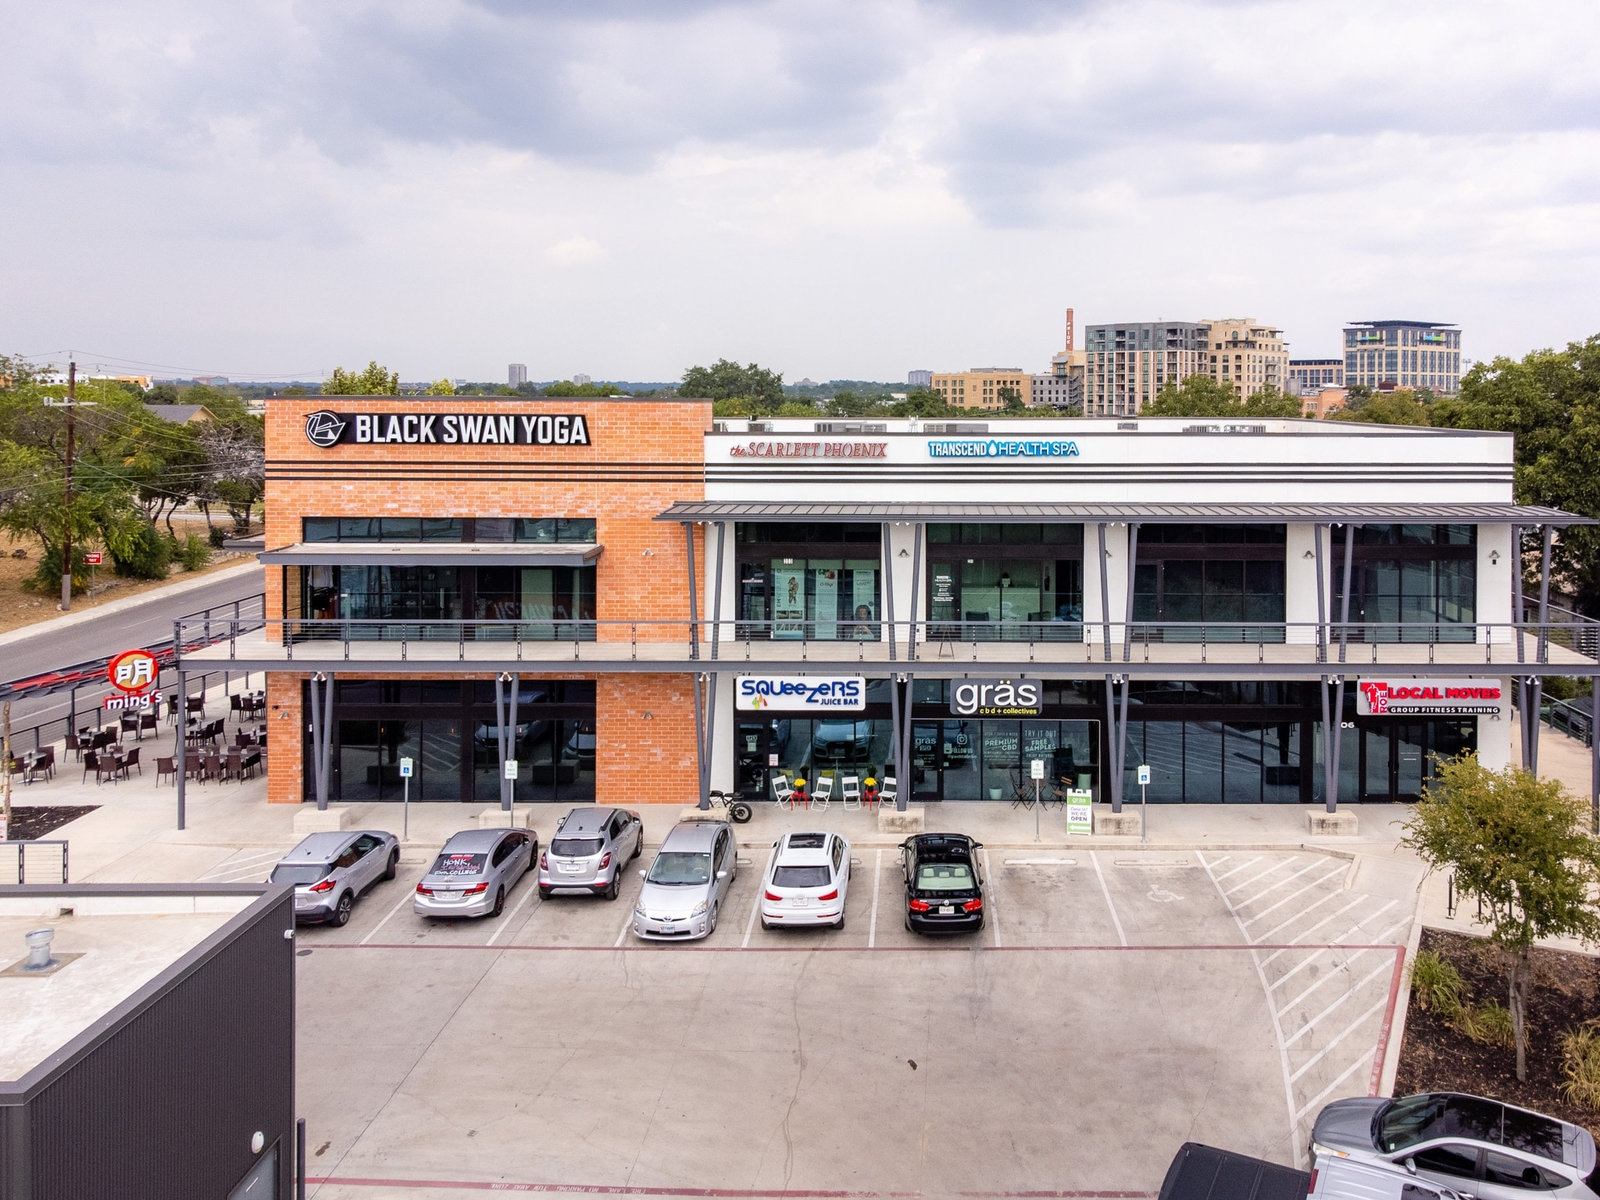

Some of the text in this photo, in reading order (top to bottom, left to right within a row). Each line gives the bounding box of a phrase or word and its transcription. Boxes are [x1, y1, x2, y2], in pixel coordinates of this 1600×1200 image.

[356, 415, 587, 444] BLACK SWAN YOGA
[730, 442, 888, 457] the SCARLETT PHOENIX
[929, 441, 1079, 456] TRANSCEND HEALTH SPA
[116, 658, 154, 685] 明
[107, 690, 163, 710] ming's
[956, 680, 1038, 715] gräs
[1387, 687, 1501, 700] LOCAL MOVES
[985, 738, 1018, 746] PREMIUM
[1025, 743, 1056, 752] SAMPLES
[1031, 738, 1048, 746] FREE
